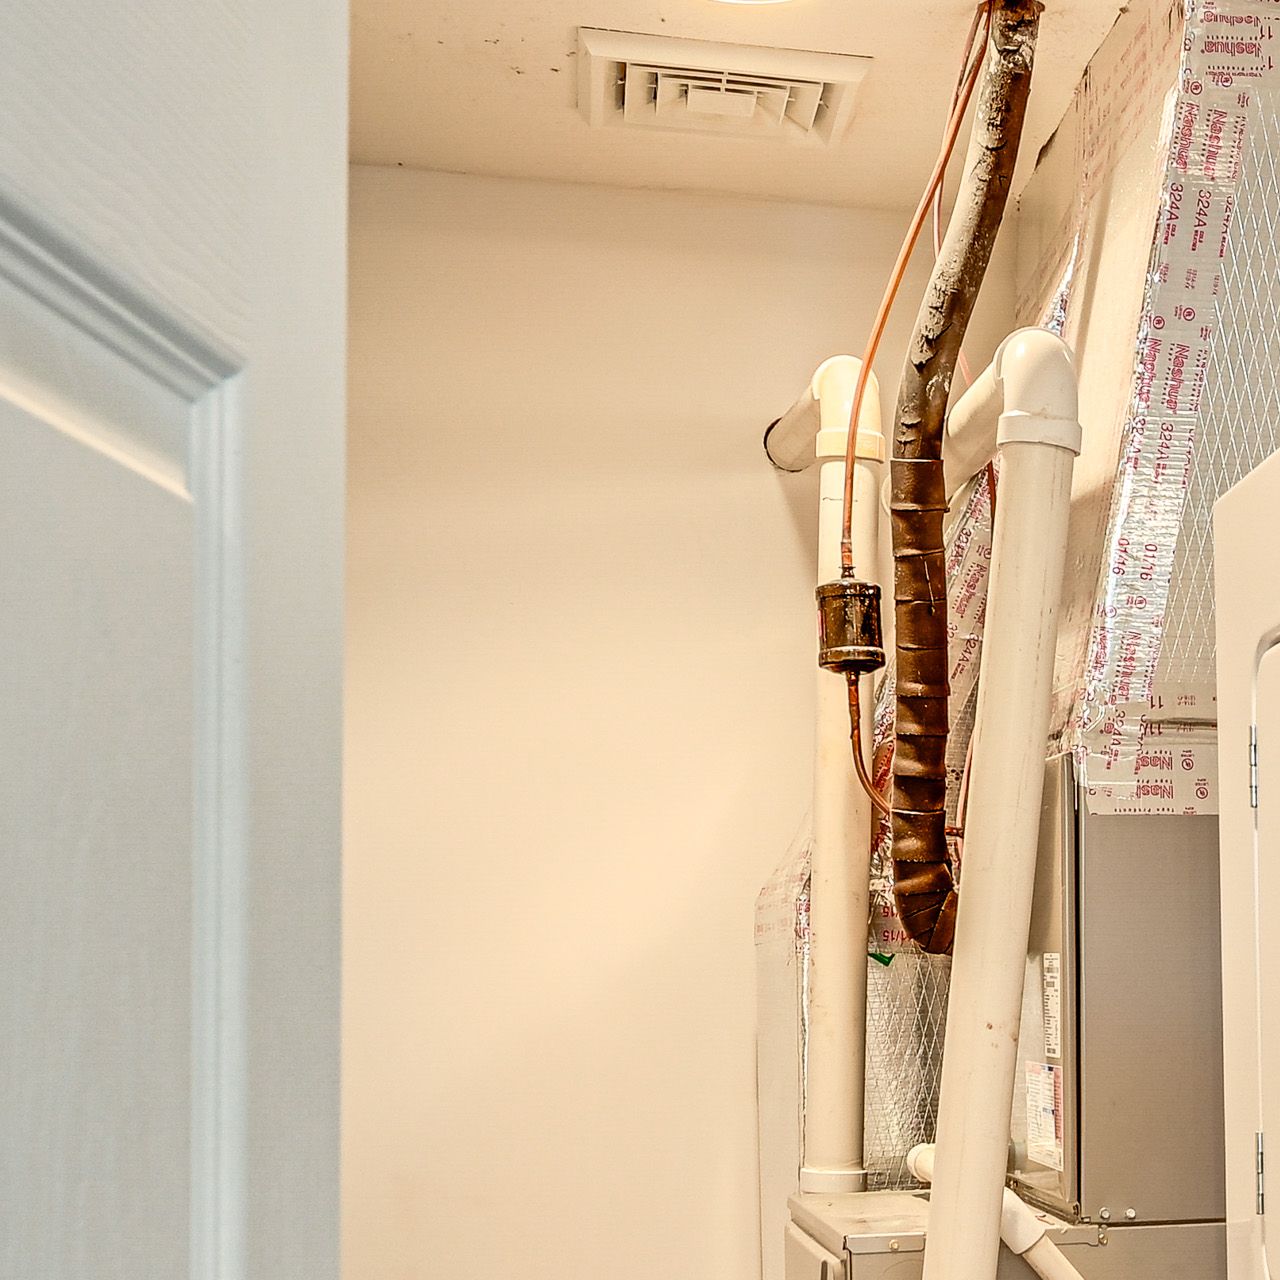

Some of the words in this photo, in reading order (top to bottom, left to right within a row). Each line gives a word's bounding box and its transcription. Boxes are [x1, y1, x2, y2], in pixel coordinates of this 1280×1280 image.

[1175, 102, 1200, 174] Nashua
[1203, 110, 1228, 182] Nashua
[1165, 182, 1184, 221] 324A
[1193, 189, 1212, 228] 324A
[1166, 343, 1191, 415] Nashua
[1155, 422, 1174, 462] 324A
[1112, 537, 1130, 575] 01/16
[1139, 543, 1158, 580] 01/16
[953, 563, 988, 619] Nashua
[959, 632, 980, 663] 324A
